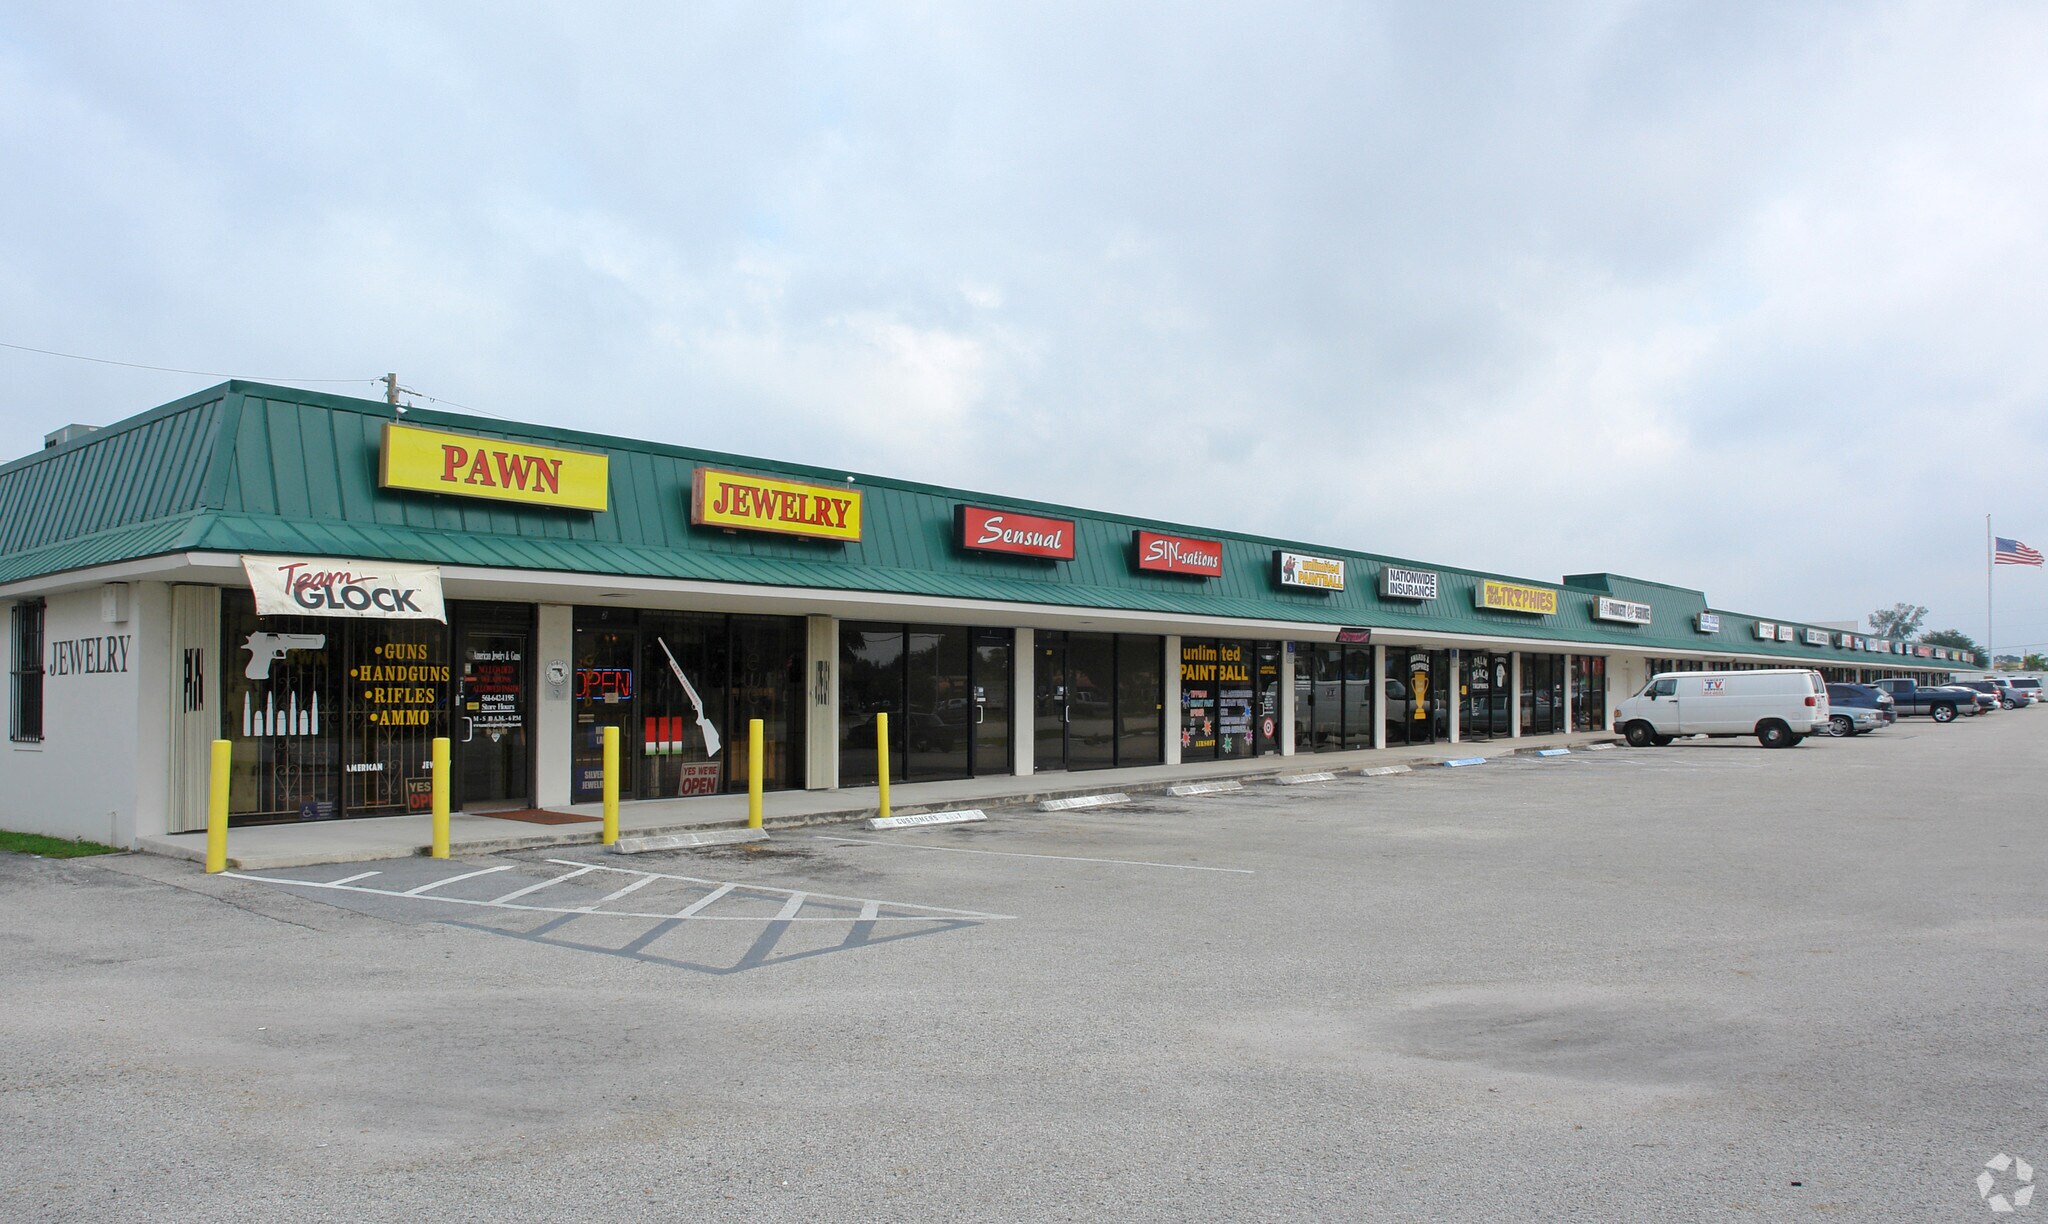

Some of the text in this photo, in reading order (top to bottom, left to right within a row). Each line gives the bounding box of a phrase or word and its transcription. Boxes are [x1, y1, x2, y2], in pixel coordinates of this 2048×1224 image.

[441, 444, 563, 494] PAWN
[713, 482, 851, 528] JEWELRY
[977, 516, 1062, 549] Sensual
[1144, 540, 1218, 568] SIN-sations
[1302, 559, 1340, 575] unlimited
[278, 563, 378, 595] Team
[1297, 570, 1342, 588] PAINTBALL
[1390, 569, 1435, 586] NATIONWIDE
[294, 582, 422, 612] GLOCK
[1390, 582, 1435, 598] INSURANCE
[50, 635, 131, 676] JEWELRY
[384, 643, 427, 660] GUNS
[1183, 644, 1241, 662] unlimted
[1474, 656, 1488, 667] PALM
[360, 665, 450, 682] HANDGUNS
[1473, 669, 1489, 680] BEACH
[576, 671, 630, 697] OPEN
[1705, 681, 1723, 689] TV
[374, 687, 435, 704] RIFLES
[379, 709, 429, 726] AMMO
[684, 766, 696, 776] YES
[409, 782, 431, 792] YES
[682, 777, 716, 795] OPEN
